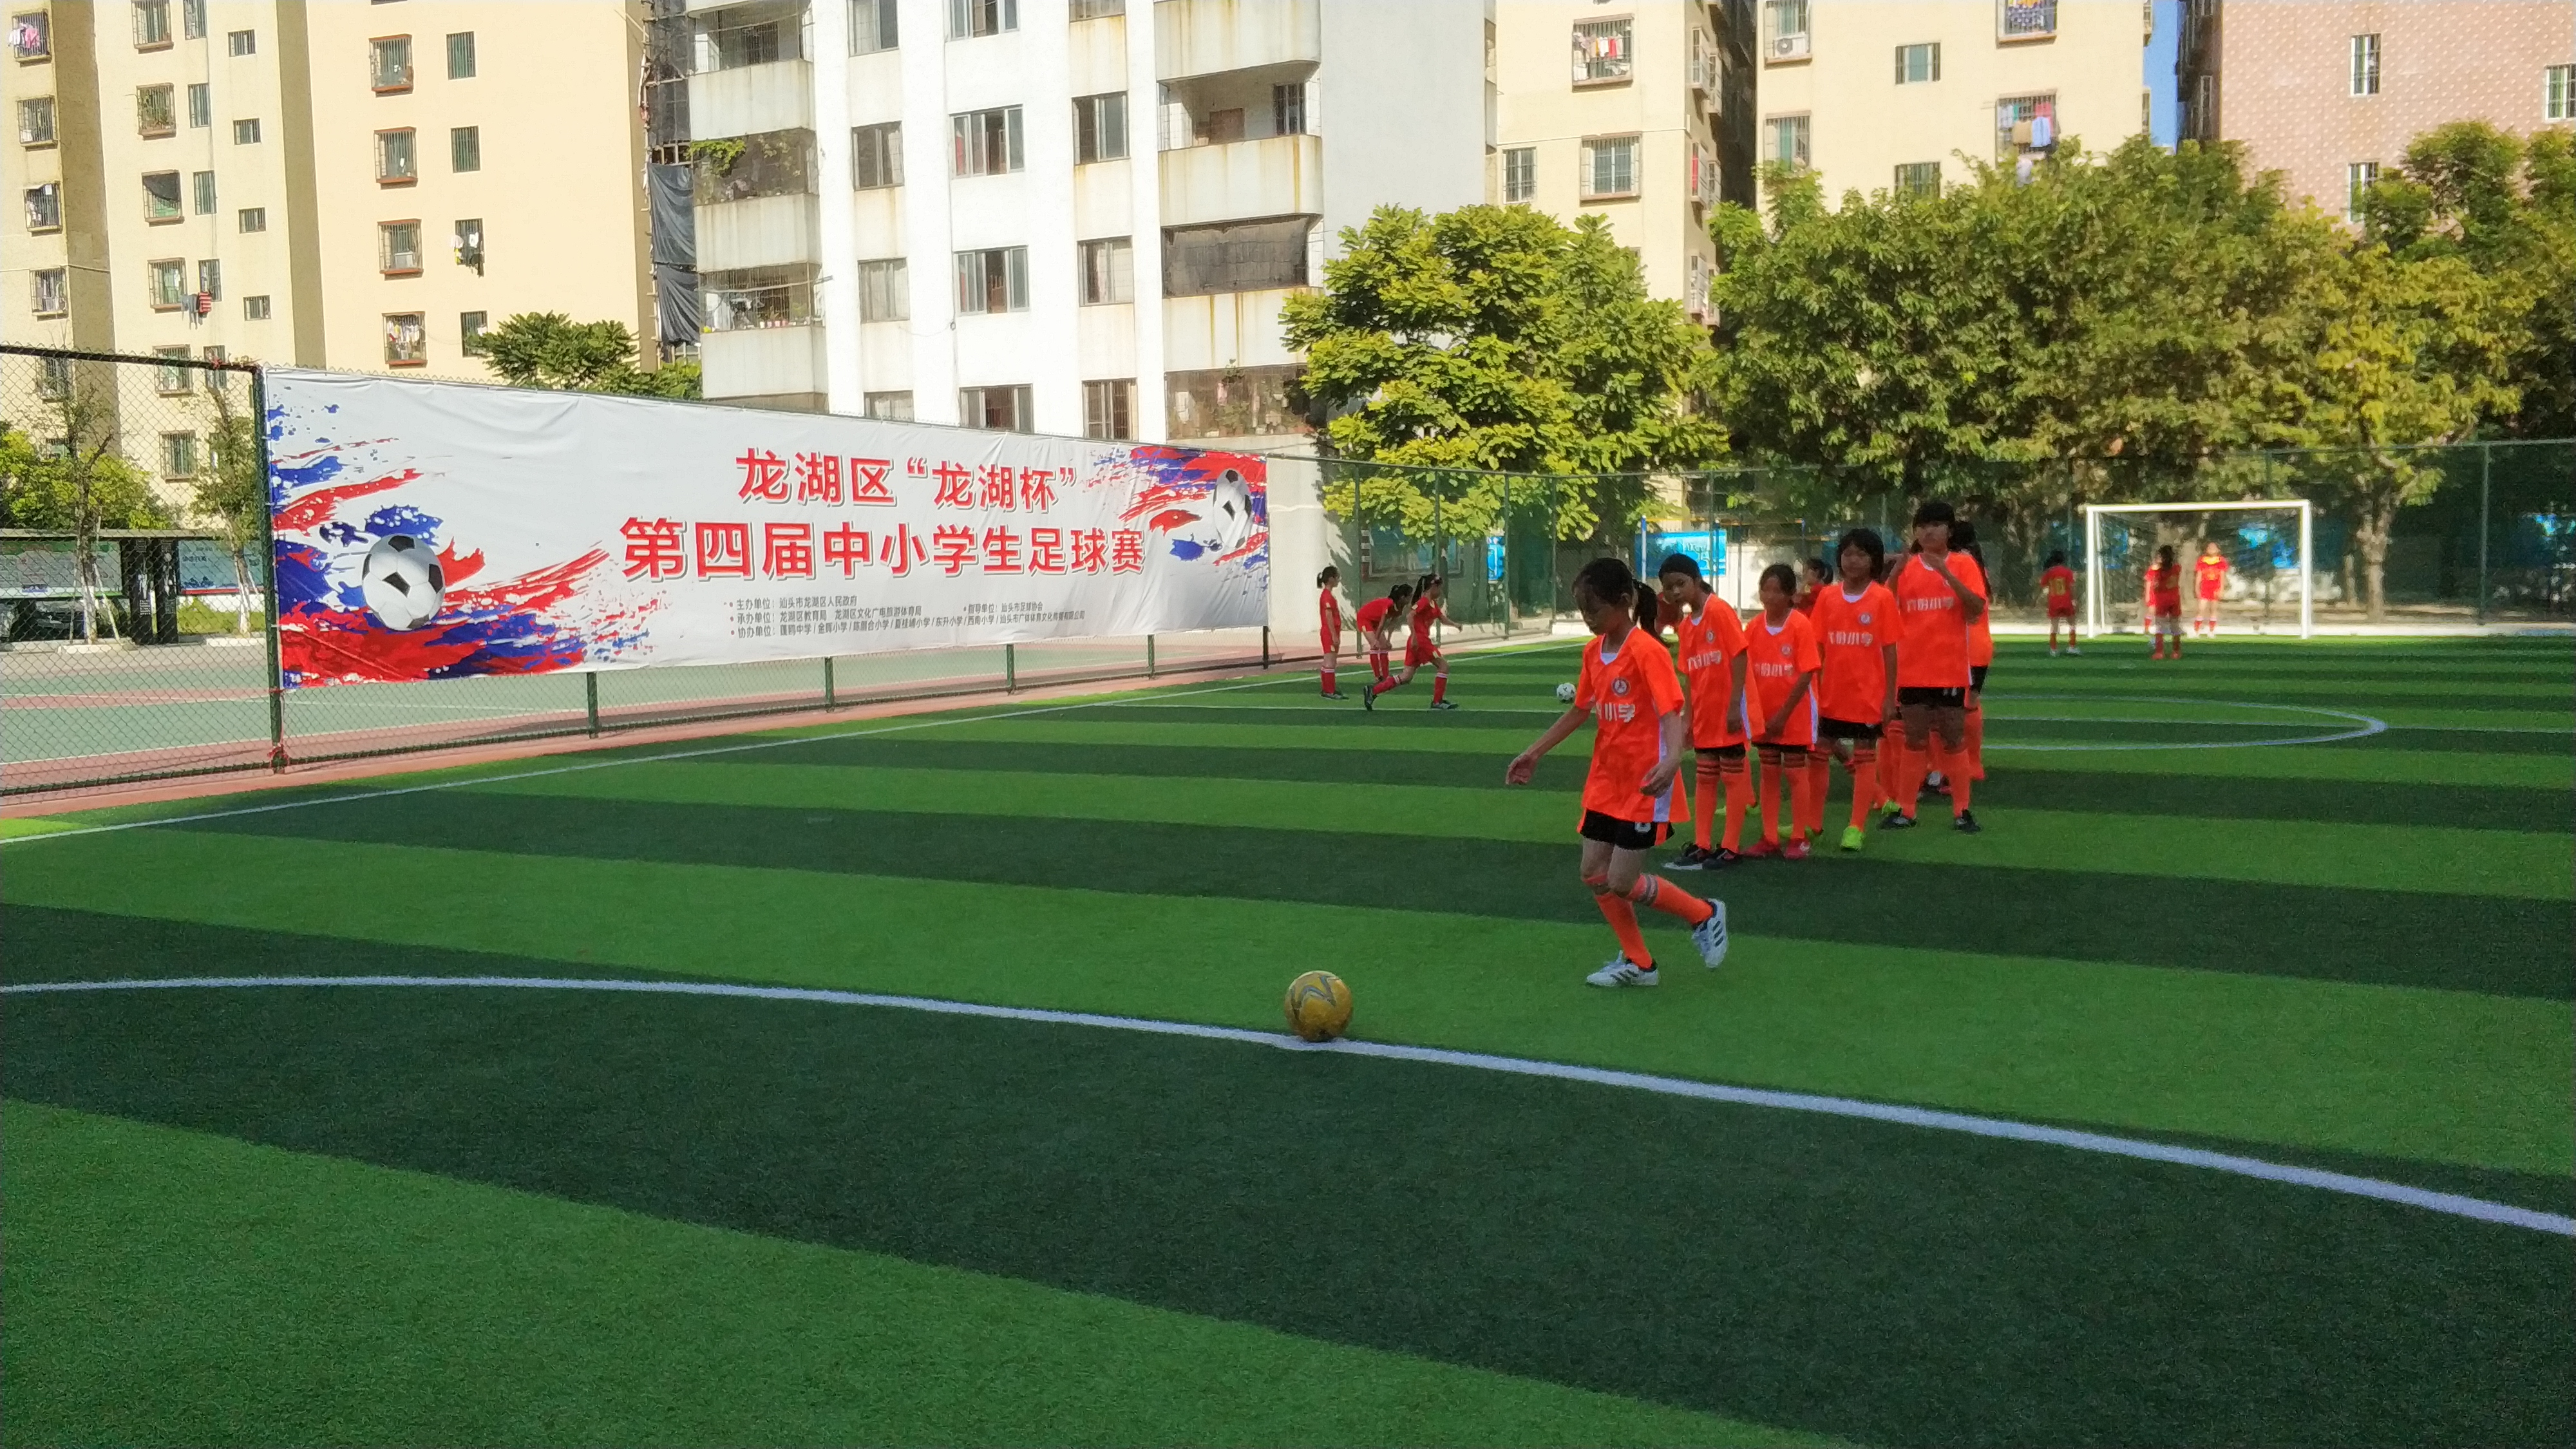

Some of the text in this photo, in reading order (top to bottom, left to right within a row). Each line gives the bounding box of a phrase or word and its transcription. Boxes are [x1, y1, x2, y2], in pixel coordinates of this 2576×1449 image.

[735, 447, 1077, 512] 龙湖区“龙湖杯”
[620, 517, 1146, 582] 第四届中小学生足球赛
